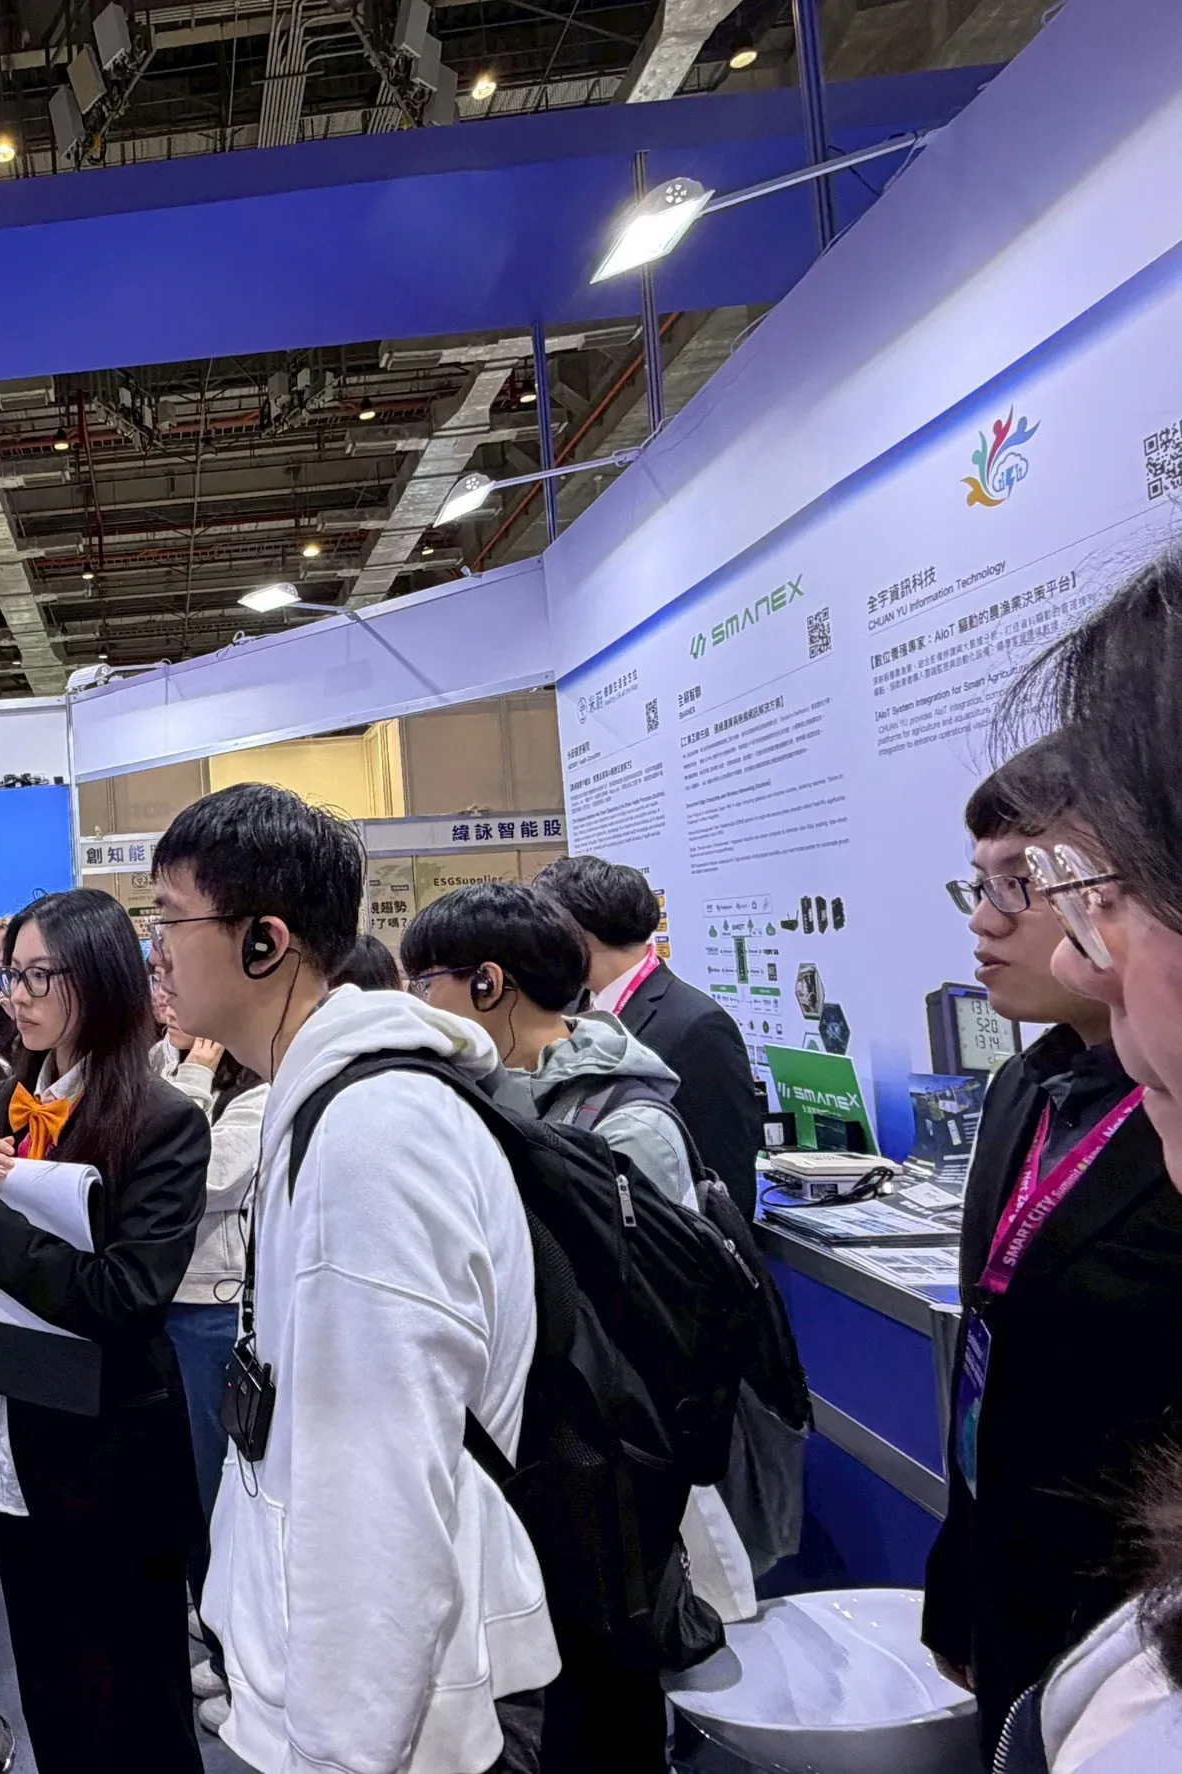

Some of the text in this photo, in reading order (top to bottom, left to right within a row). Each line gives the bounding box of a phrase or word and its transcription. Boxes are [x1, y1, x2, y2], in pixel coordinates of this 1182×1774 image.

[712, 573, 805, 647] SMANEX
[867, 565, 937, 614] 全宇資訊科技
[868, 560, 1006, 631] CHUAN YU Information Technology
[892, 702, 914, 716] System
[916, 689, 951, 707] Integration
[952, 684, 962, 695] for
[964, 676, 985, 692] Smart
[452, 818, 562, 842] 緯詠智能股
[977, 1018, 998, 1033] 520
[1003, 1220, 1035, 1267] SMART
[1031, 1195, 1056, 1224] CITY
[1051, 1168, 1083, 1201] Summit
